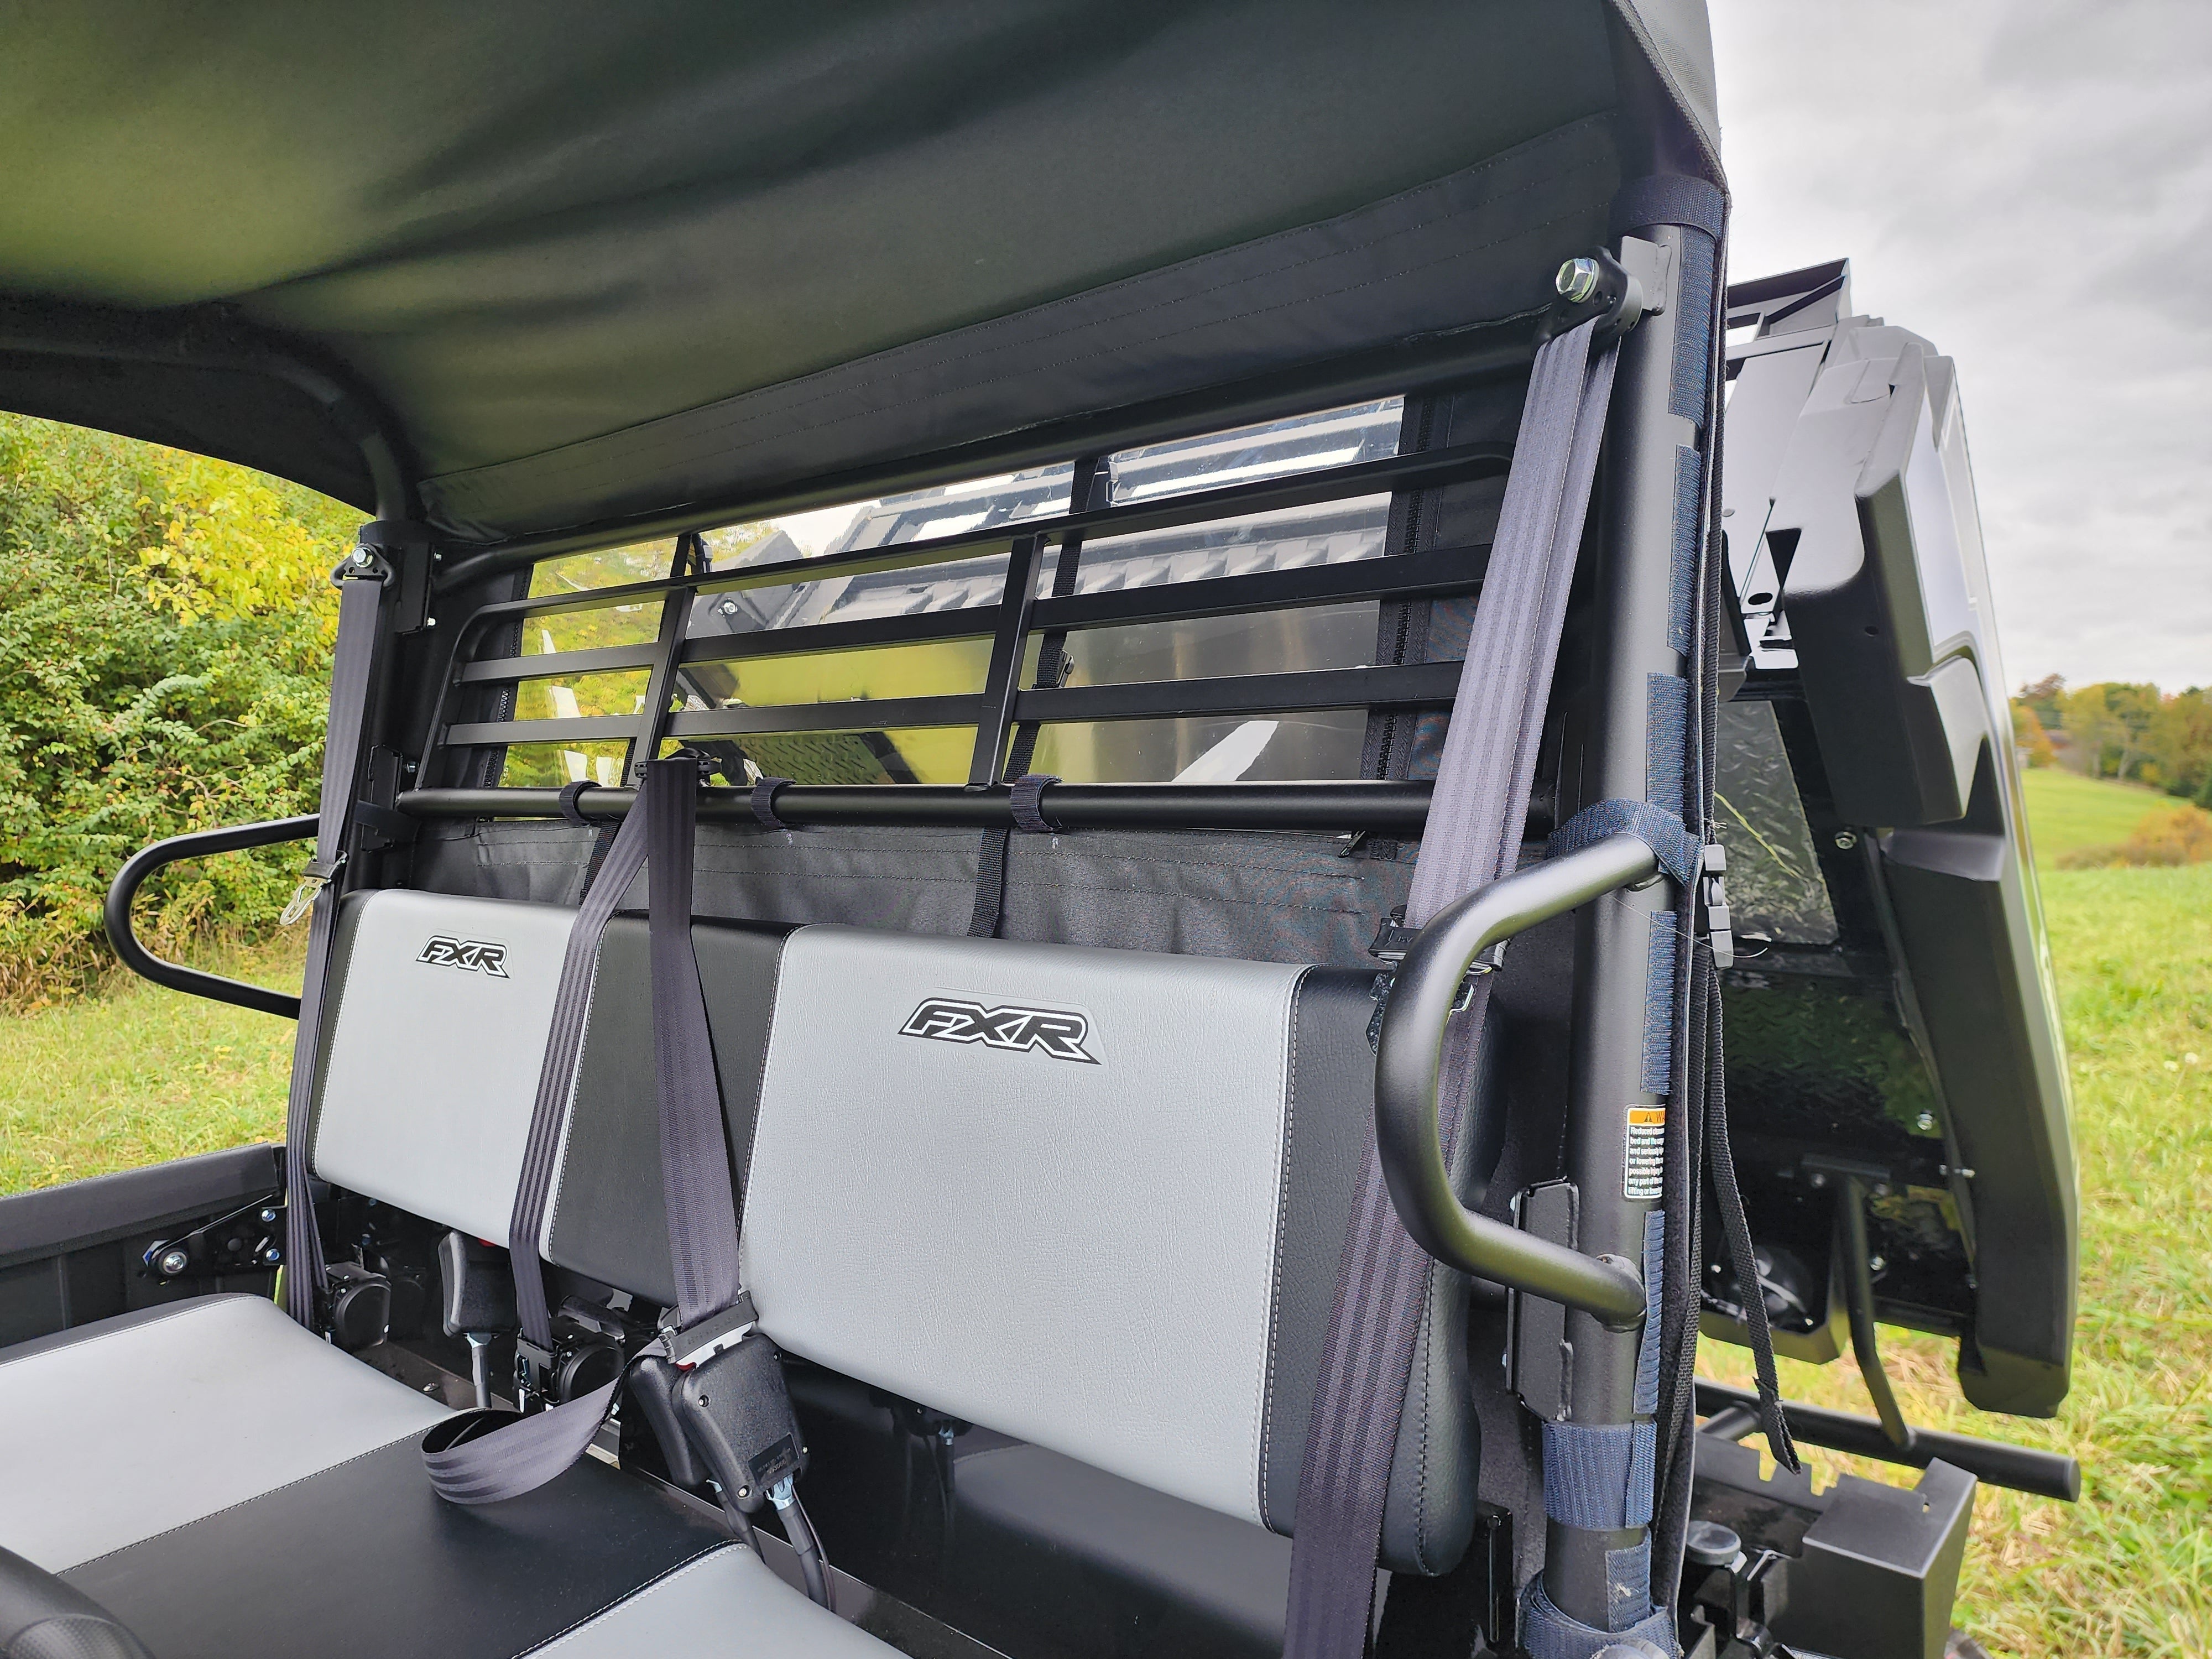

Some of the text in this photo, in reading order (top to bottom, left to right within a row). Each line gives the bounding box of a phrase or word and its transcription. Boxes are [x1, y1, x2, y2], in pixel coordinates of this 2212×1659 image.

[418, 936, 507, 976] FXR
[902, 999, 1092, 1060] FXR
[1630, 1126, 1652, 1135] Reduced
[1630, 1136, 1641, 1145] bed
[1641, 1147, 1659, 1156] seriously
[1636, 1157, 1655, 1166] lowering
[1629, 1167, 1650, 1177] possible
[1628, 1178, 1639, 1186] any
[1639, 1177, 1649, 1187] part
[1628, 1186, 1644, 1196] lifting
